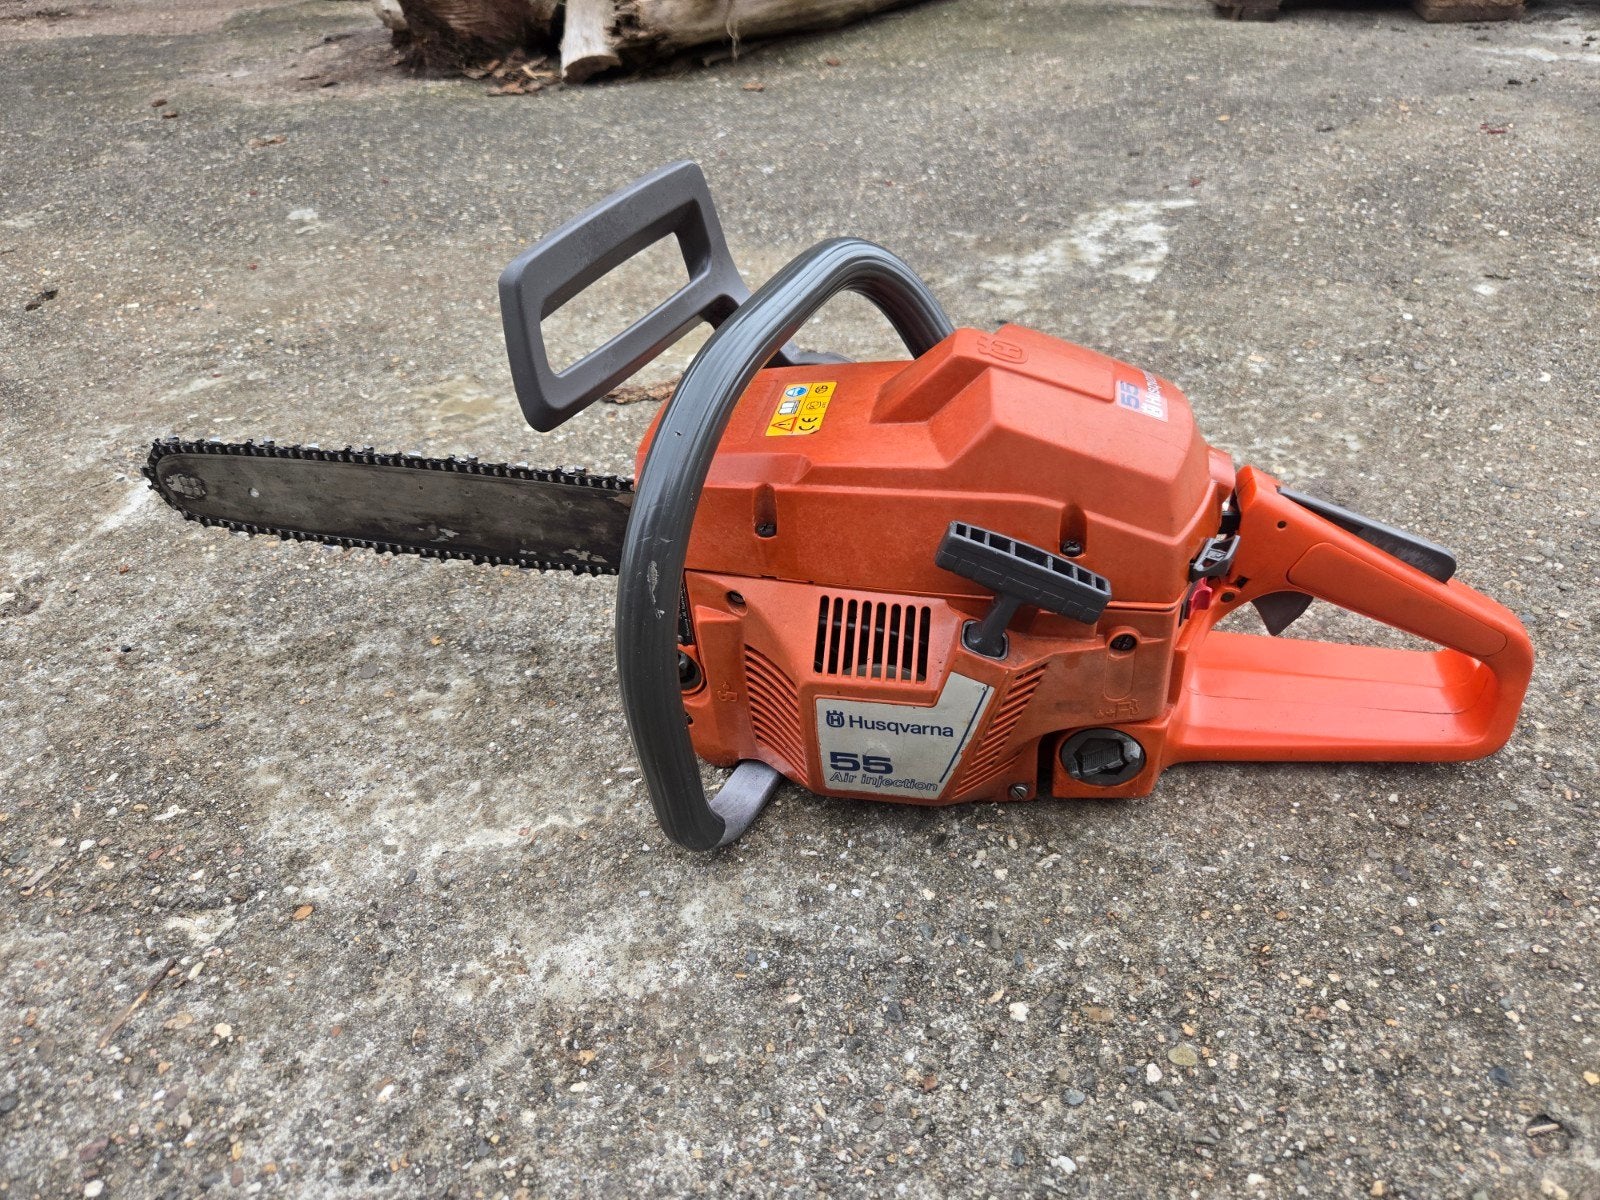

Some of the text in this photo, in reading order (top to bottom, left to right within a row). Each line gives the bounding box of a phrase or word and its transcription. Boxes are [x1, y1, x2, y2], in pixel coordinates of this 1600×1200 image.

[1120, 381, 1139, 409] 55
[849, 715, 954, 738] Husqvarna
[829, 751, 894, 775] 55
[830, 772, 938, 792] Air injection
